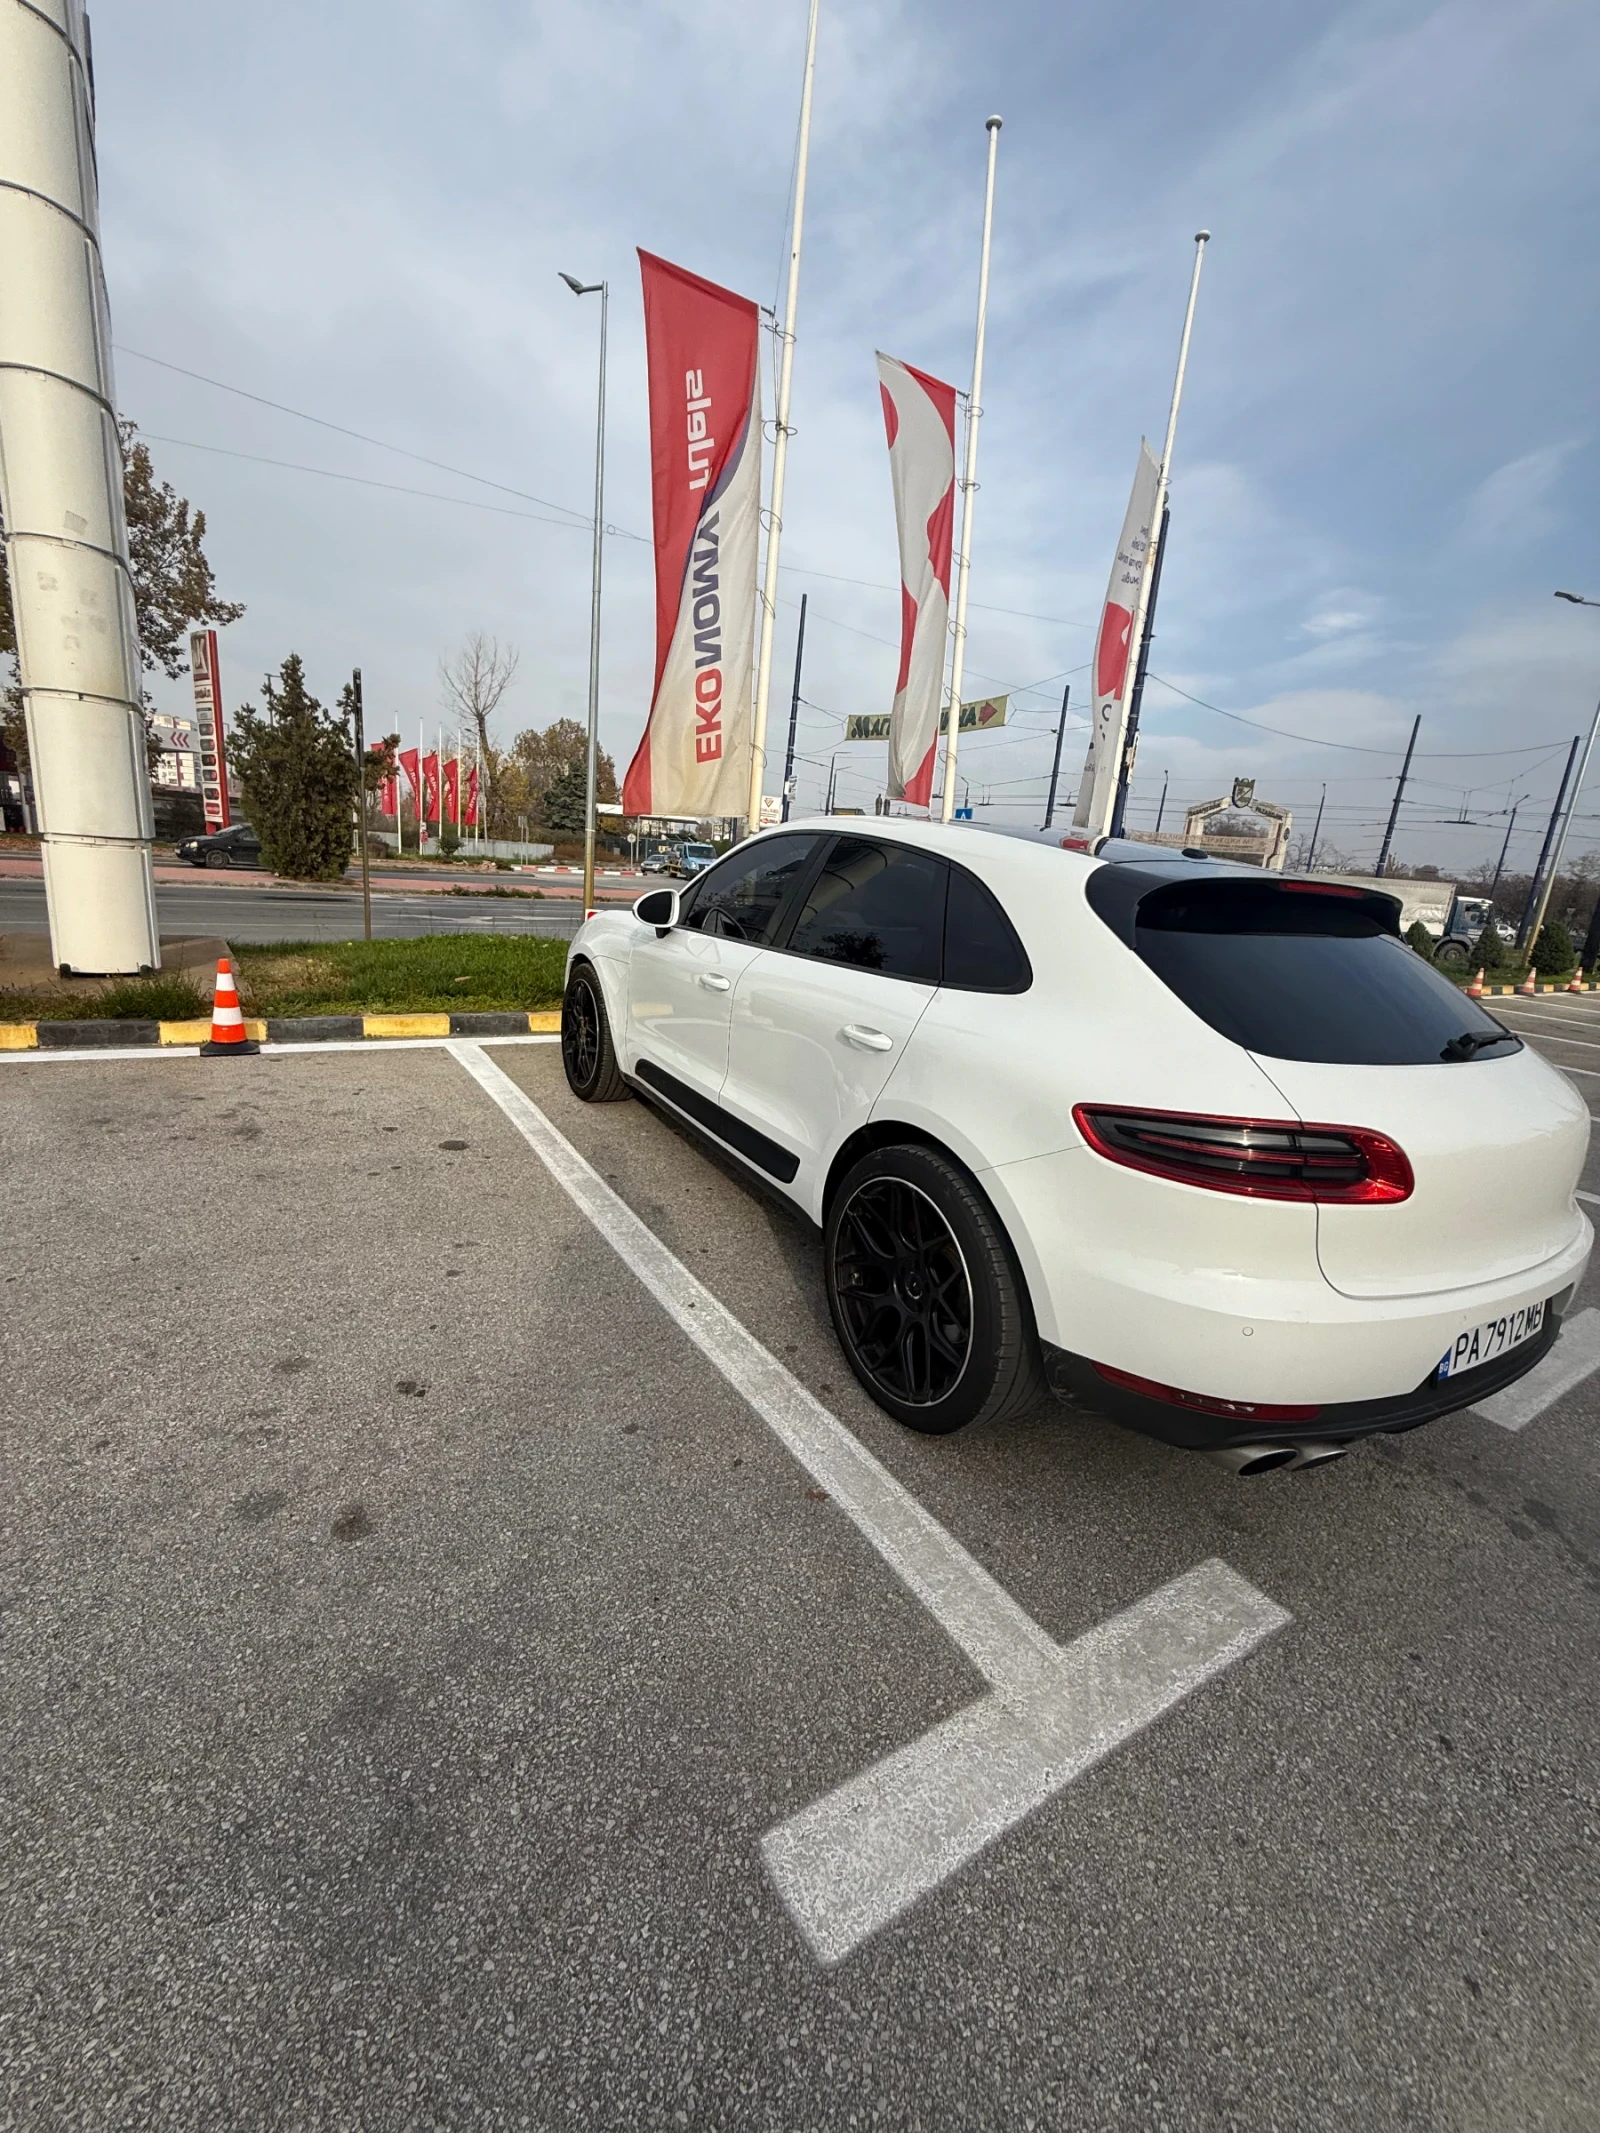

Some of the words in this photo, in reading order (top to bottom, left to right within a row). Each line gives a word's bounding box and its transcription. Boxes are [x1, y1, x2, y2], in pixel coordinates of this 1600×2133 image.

[1453, 1328, 1479, 1369] PA
[1483, 1309, 1525, 1357] 7912
[1438, 1361, 1449, 1374] BG
